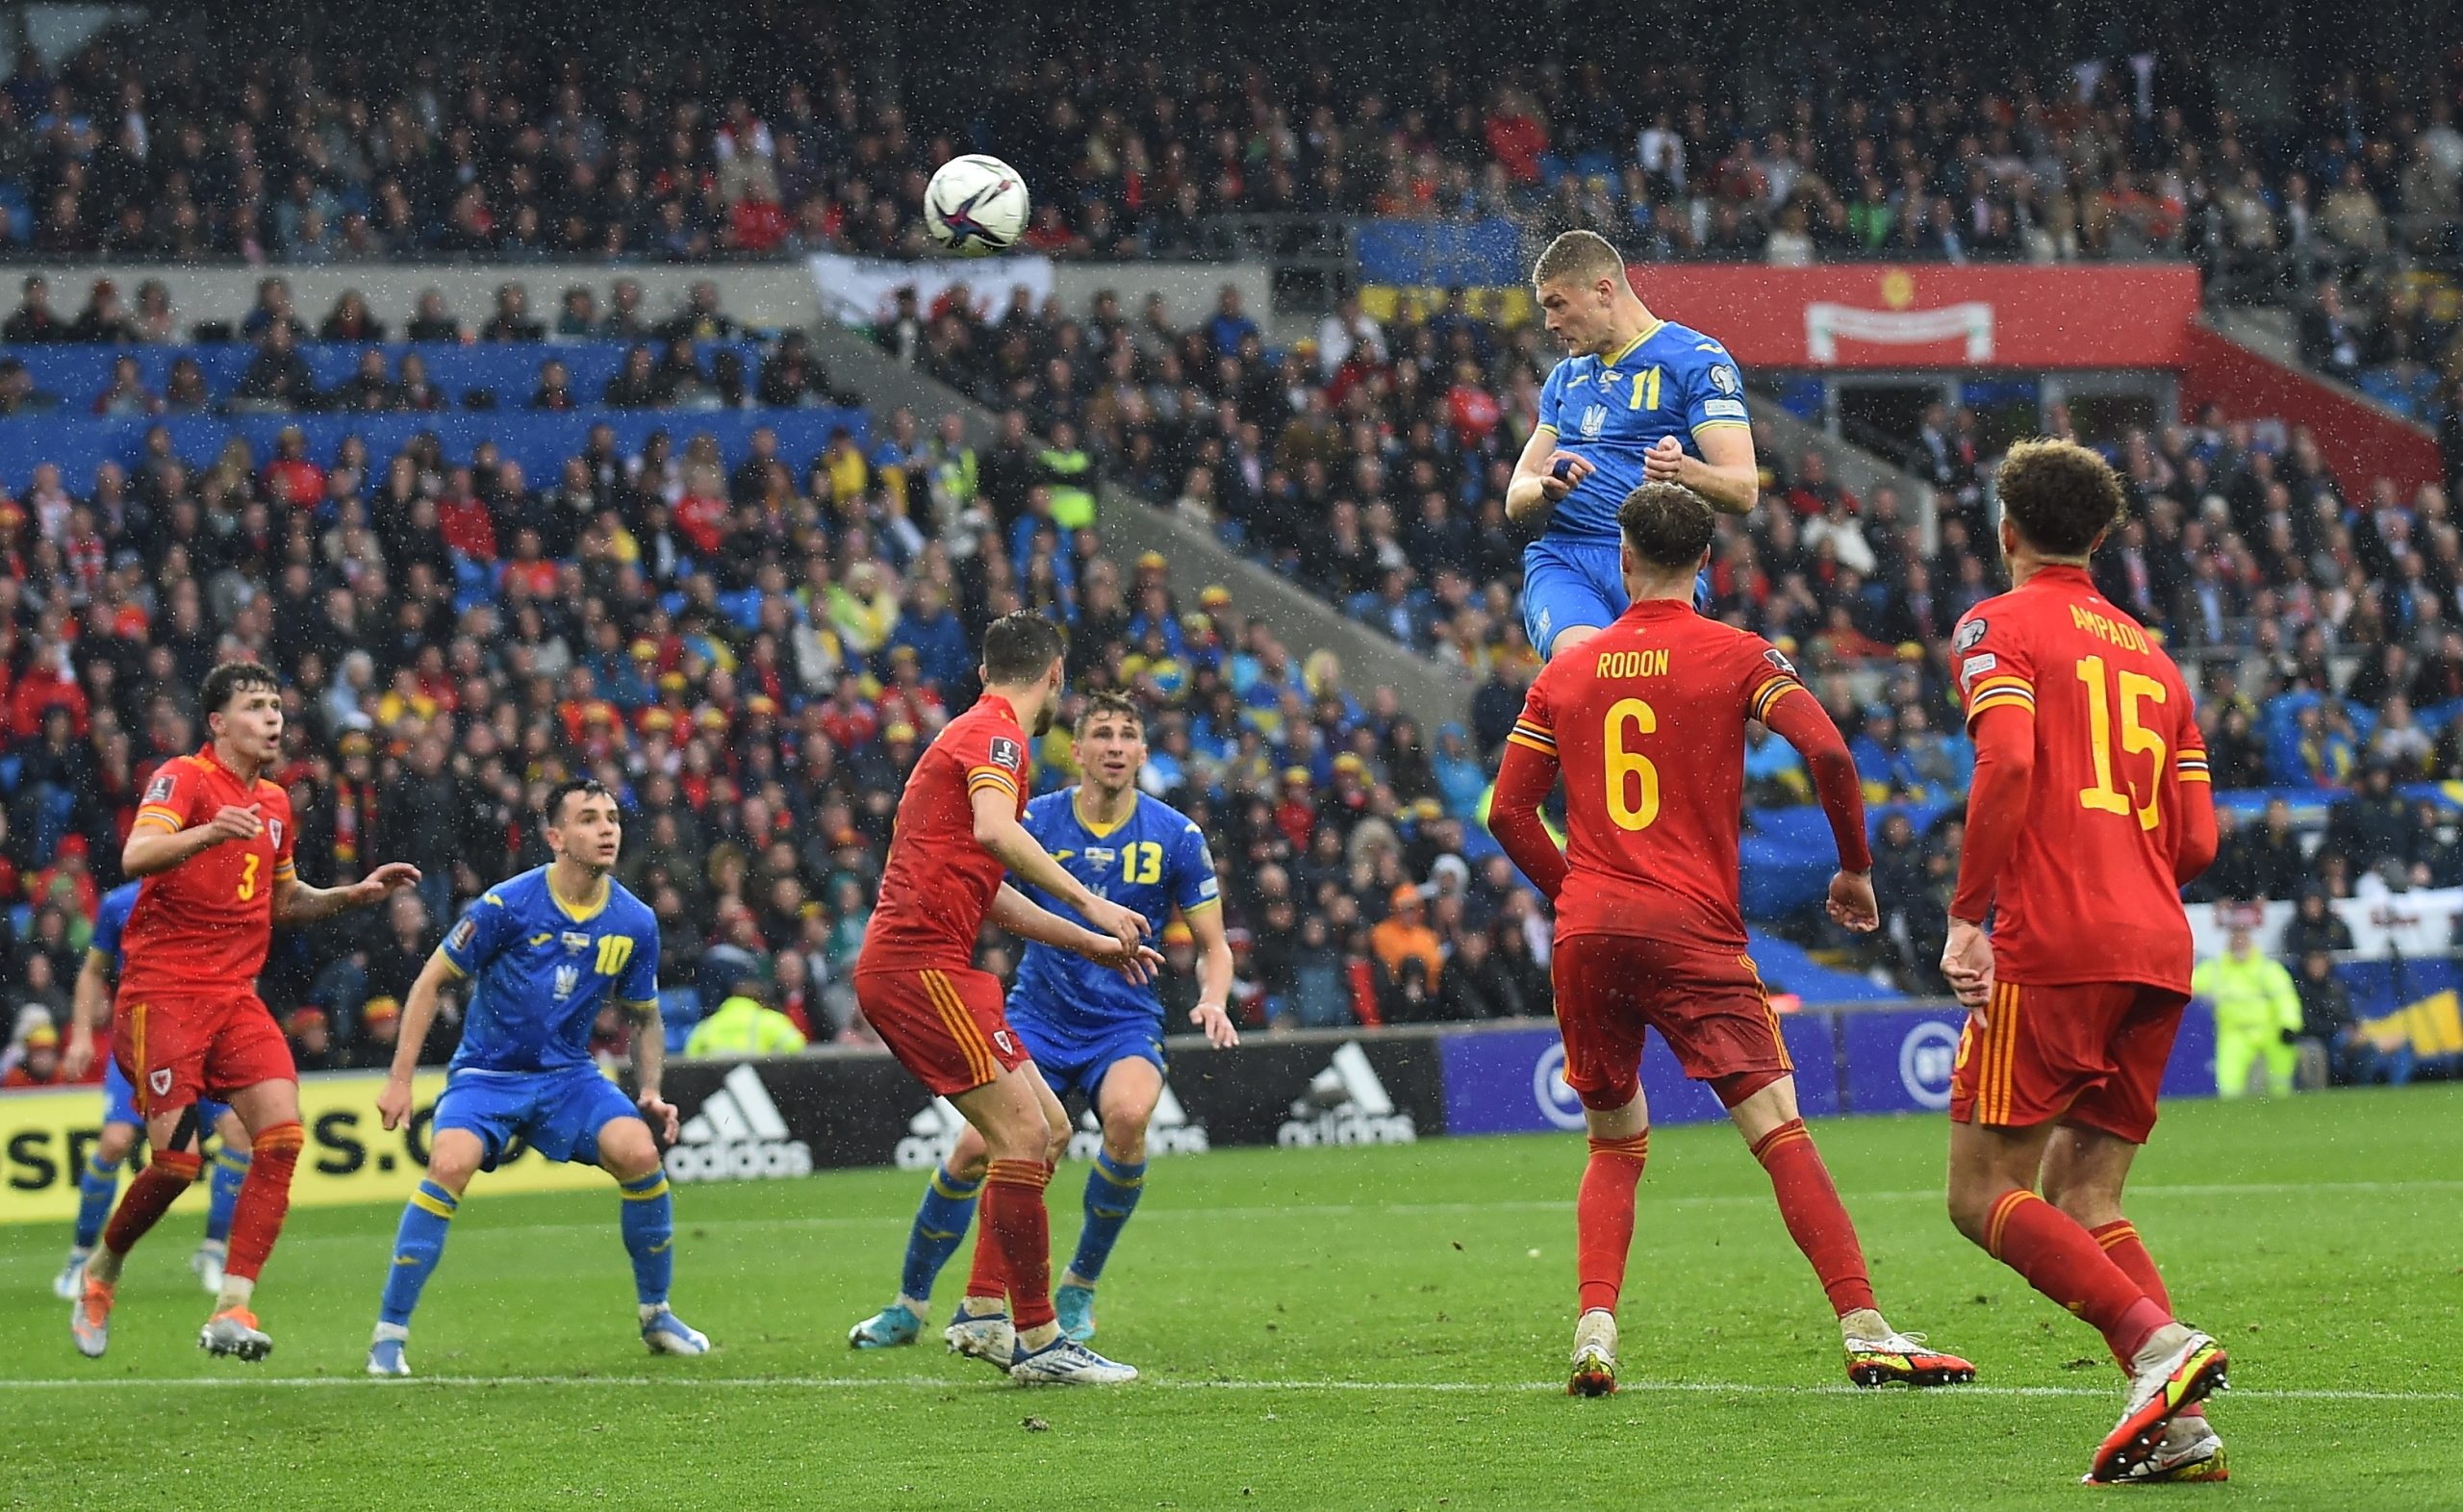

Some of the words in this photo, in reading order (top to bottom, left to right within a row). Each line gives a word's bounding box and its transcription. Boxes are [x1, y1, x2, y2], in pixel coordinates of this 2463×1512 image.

[1628, 365, 1661, 411] 11
[2069, 603, 2149, 655] AMPADU
[1596, 648, 1670, 679] RODON
[1603, 697, 1660, 831] 6
[2075, 654, 2167, 831] 15
[237, 853, 260, 901] 3
[1121, 841, 1163, 884] 13
[594, 934, 635, 976] 10
[1277, 1112, 1417, 1147] adidas
[664, 1139, 813, 1182] adidas
